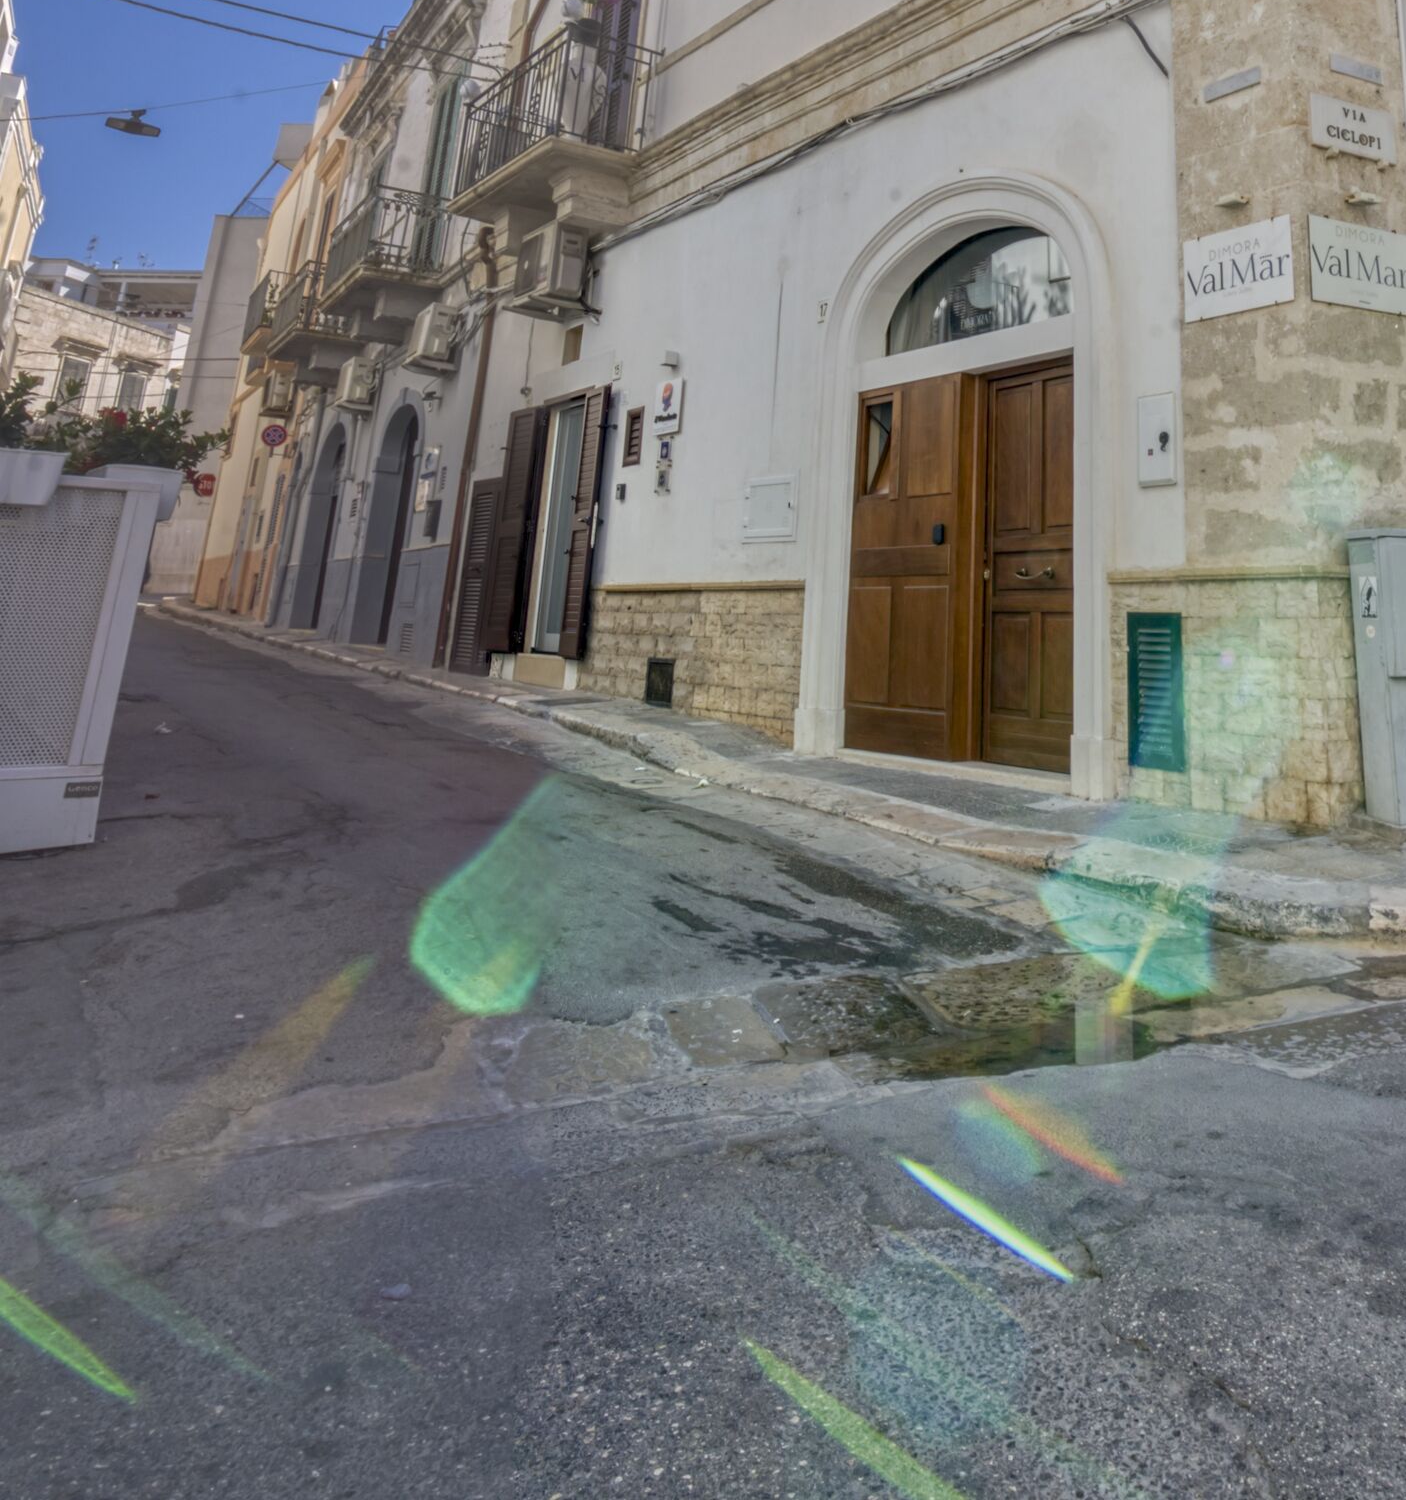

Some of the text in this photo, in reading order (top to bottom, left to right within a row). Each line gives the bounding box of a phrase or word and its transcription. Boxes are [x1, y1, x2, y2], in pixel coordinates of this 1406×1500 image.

[1342, 107, 1367, 123] VIA
[1326, 124, 1383, 150] CICLOPI
[1335, 224, 1386, 247] DIMORA
[1208, 237, 1261, 262] DIMORA
[1311, 243, 1353, 279] Val
[1186, 261, 1225, 297] Val
[820, 302, 829, 317] 17
